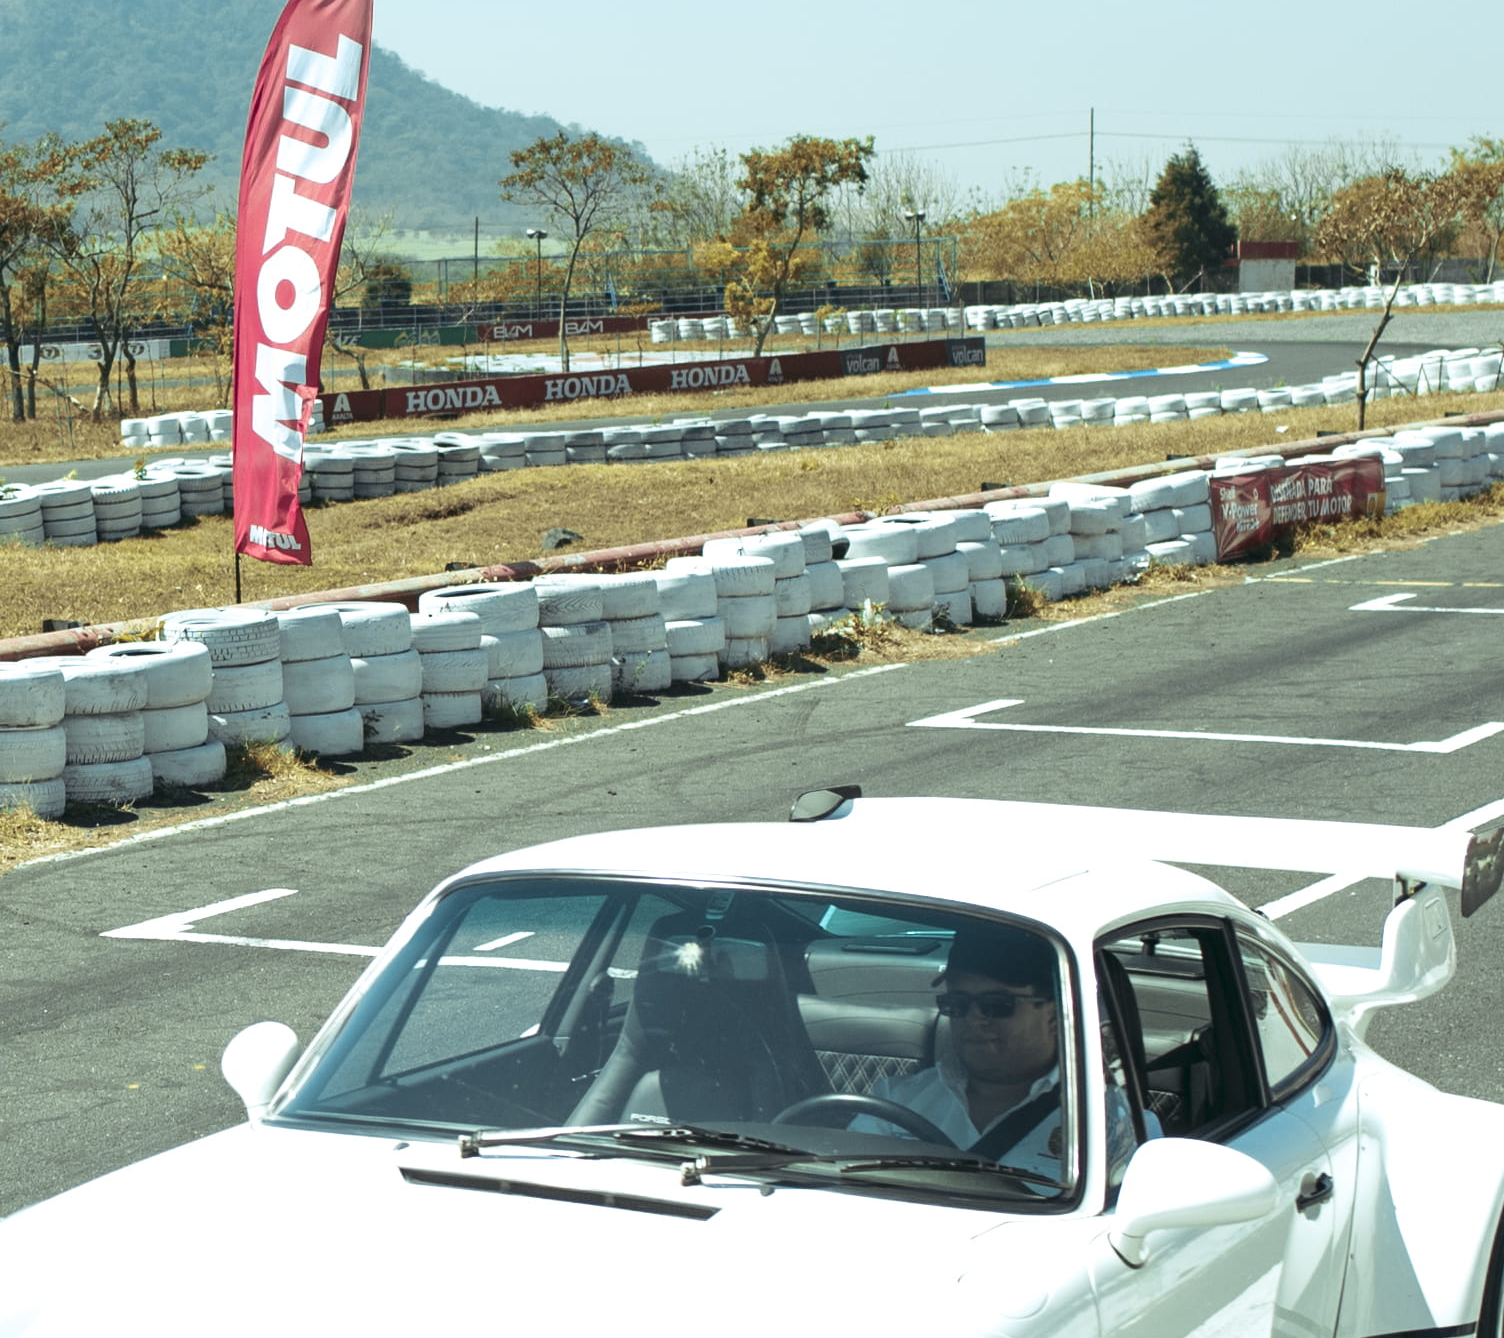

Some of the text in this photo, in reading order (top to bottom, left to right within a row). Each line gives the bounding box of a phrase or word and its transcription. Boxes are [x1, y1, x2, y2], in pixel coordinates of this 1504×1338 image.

[252, 33, 363, 464] MOTUL
[544, 373, 632, 401] HONDA
[670, 364, 751, 390] HONDA
[405, 384, 502, 413] HONDA
